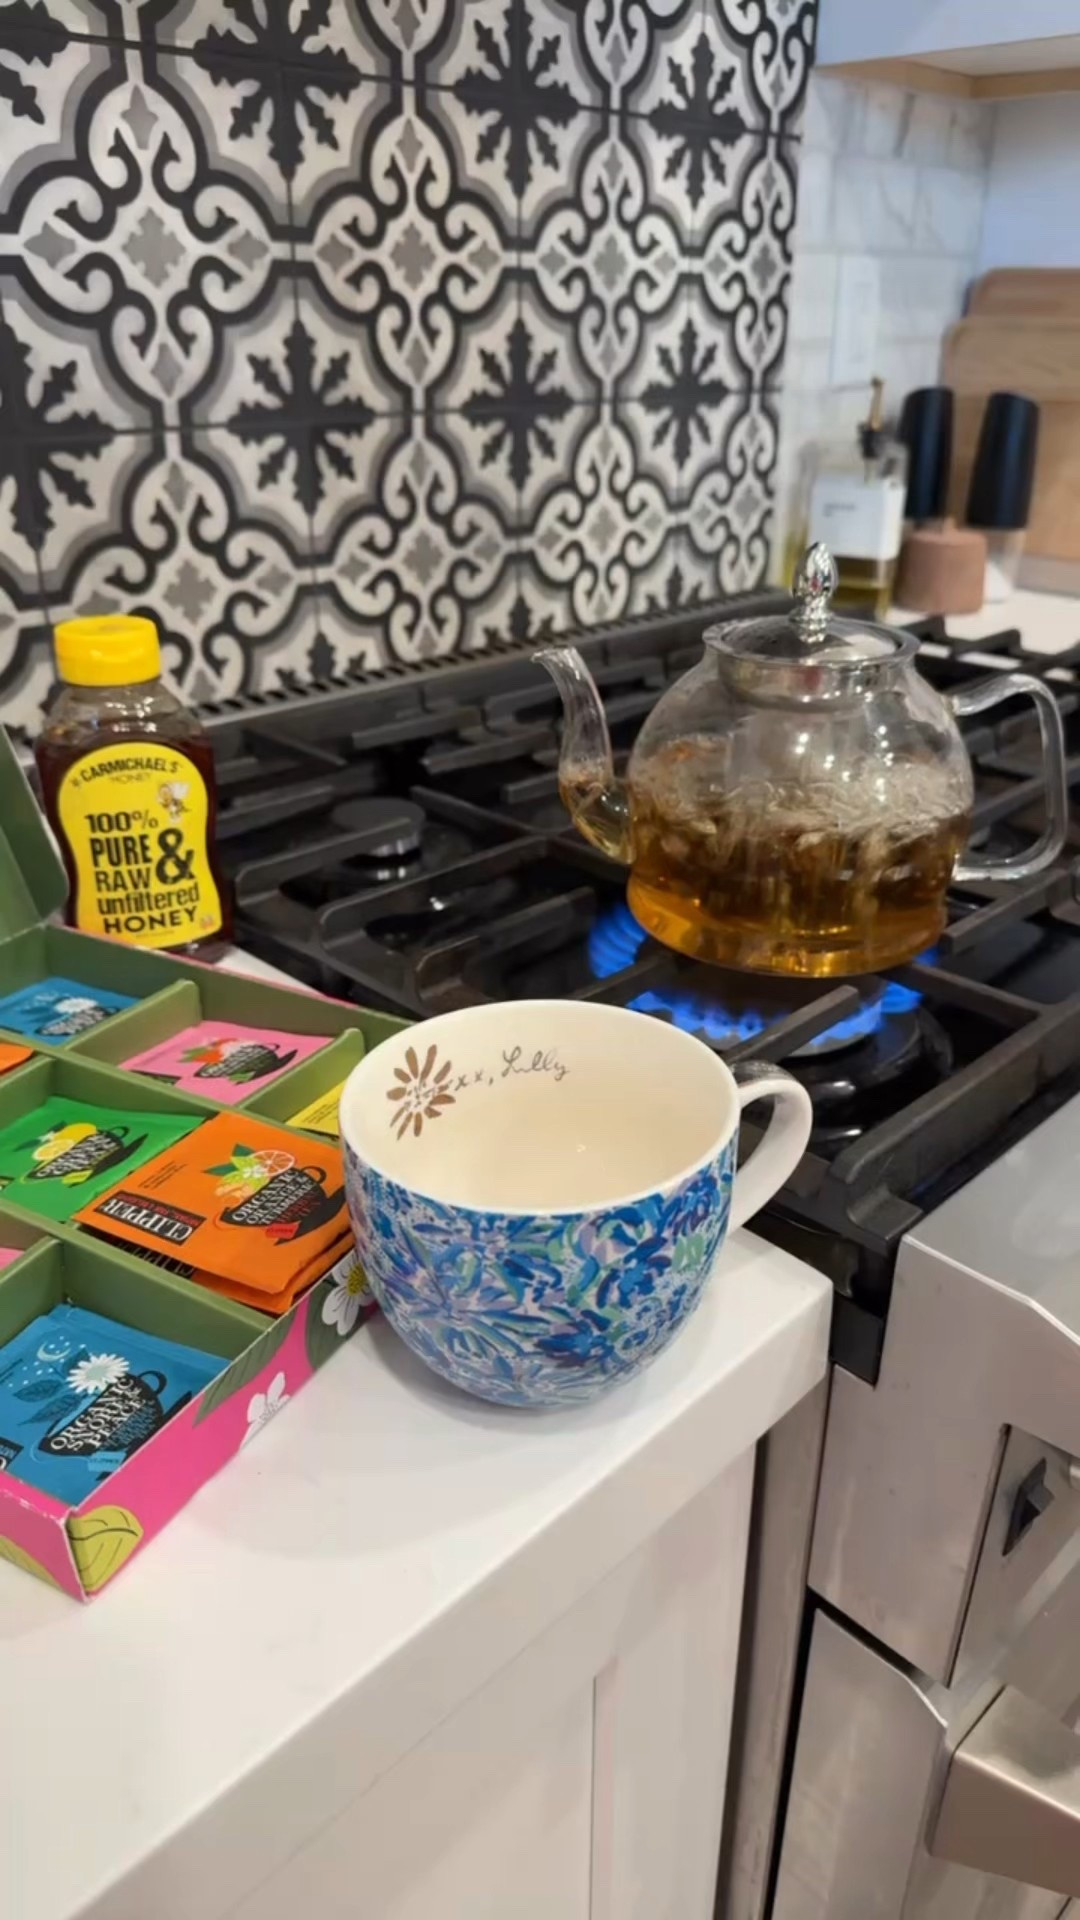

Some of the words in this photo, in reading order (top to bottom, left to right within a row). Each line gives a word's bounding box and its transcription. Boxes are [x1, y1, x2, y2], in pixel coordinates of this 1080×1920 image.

[85, 809, 158, 833] 100%
[89, 834, 152, 867] PURE
[156, 828, 195, 885] &
[94, 867, 151, 892] RAW
[97, 883, 200, 915] unfiltered
[103, 906, 197, 934] HONEY
[232, 1170, 298, 1220] ORGANIC
[246, 1182, 297, 1223] ORANGE
[260, 1179, 314, 1224] TURMERIC
[102, 1199, 192, 1240] CLIPPER
[50, 1376, 134, 1450] ORGANIC
[66, 1395, 128, 1451] SNORE
[88, 1398, 146, 1448] PEACE
